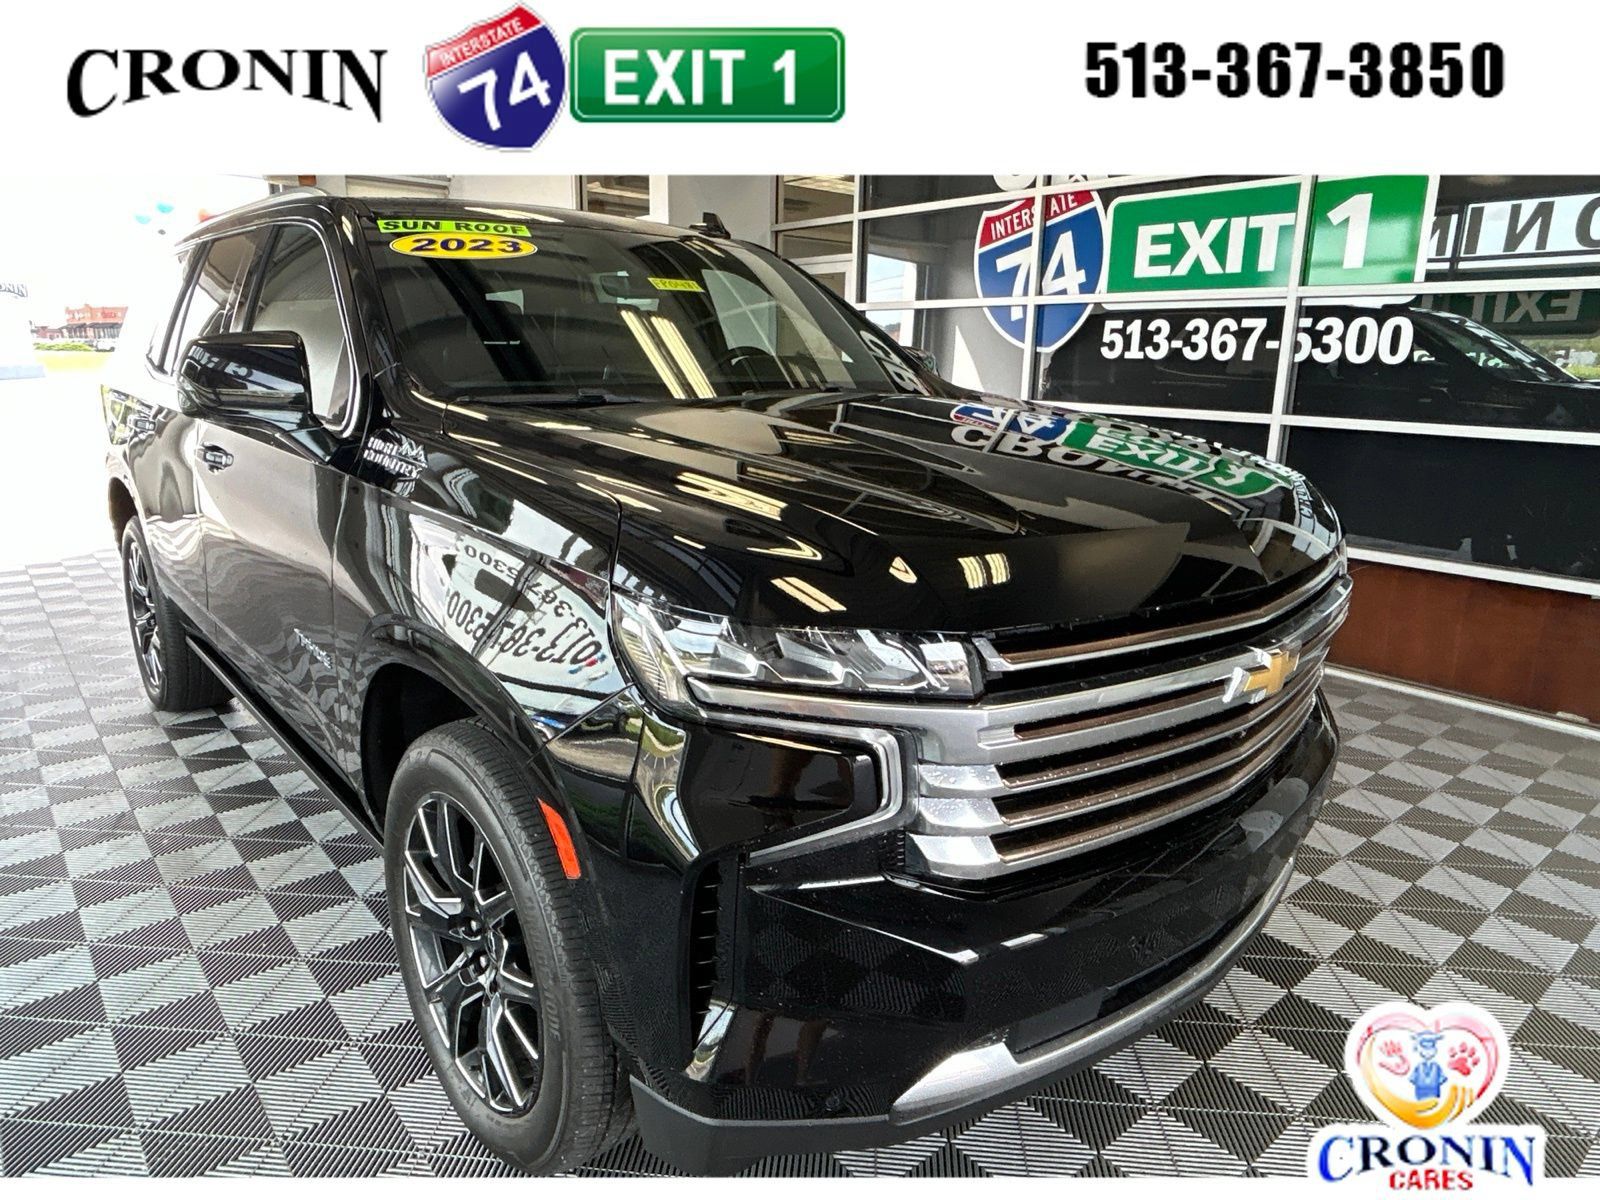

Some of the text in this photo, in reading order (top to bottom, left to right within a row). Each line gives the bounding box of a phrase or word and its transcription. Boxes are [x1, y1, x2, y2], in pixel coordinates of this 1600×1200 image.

[382, 220, 527, 235] SUN ROOF
[991, 192, 1079, 240] INTERATE
[1132, 193, 1373, 279] EXIT 1
[410, 238, 523, 253] 2023
[996, 230, 1087, 322] 74
[1100, 316, 1415, 366] 513-367-5300
